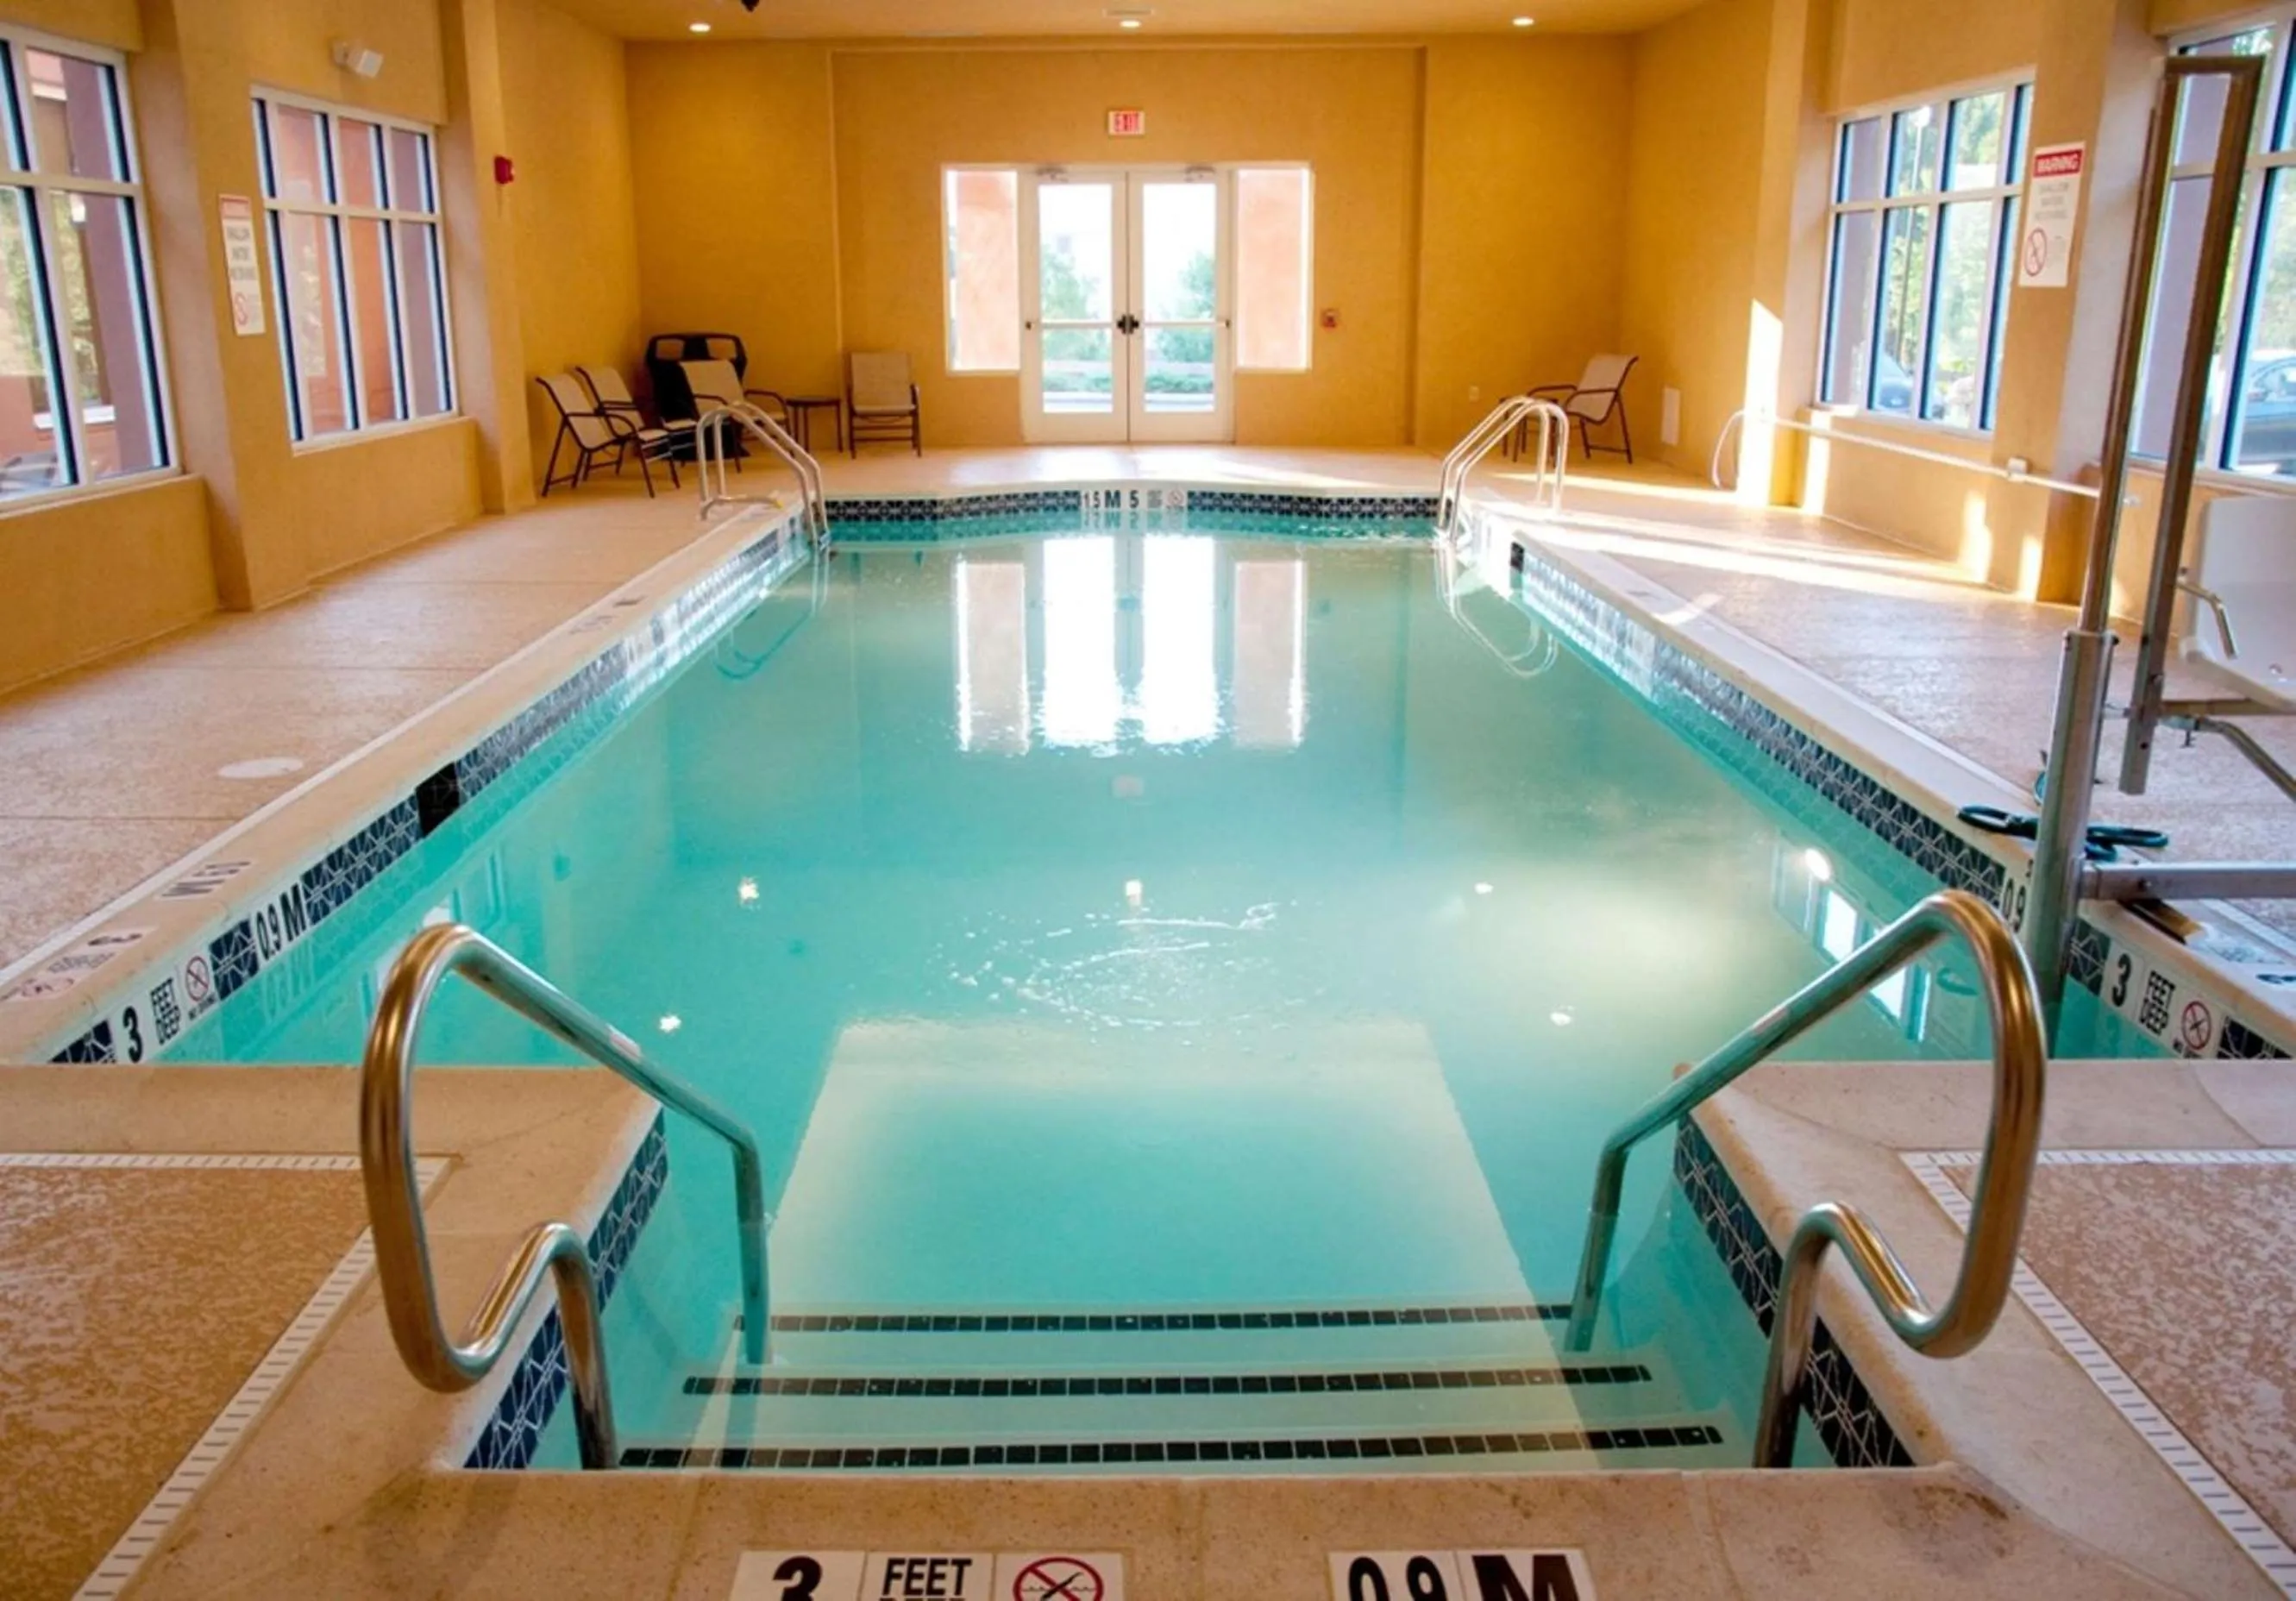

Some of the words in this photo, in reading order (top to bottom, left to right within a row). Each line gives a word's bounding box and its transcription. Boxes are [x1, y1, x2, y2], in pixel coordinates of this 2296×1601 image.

[1113, 113, 1140, 132] EXIT
[1105, 490, 1120, 508] M
[1130, 490, 1139, 508] 5
[280, 882, 306, 942] M
[150, 976, 177, 1018] FEET
[2112, 953, 2131, 1008] 3
[122, 1006, 142, 1063] 3
[156, 1005, 180, 1045] DEEP
[882, 1558, 972, 1596] FEET
